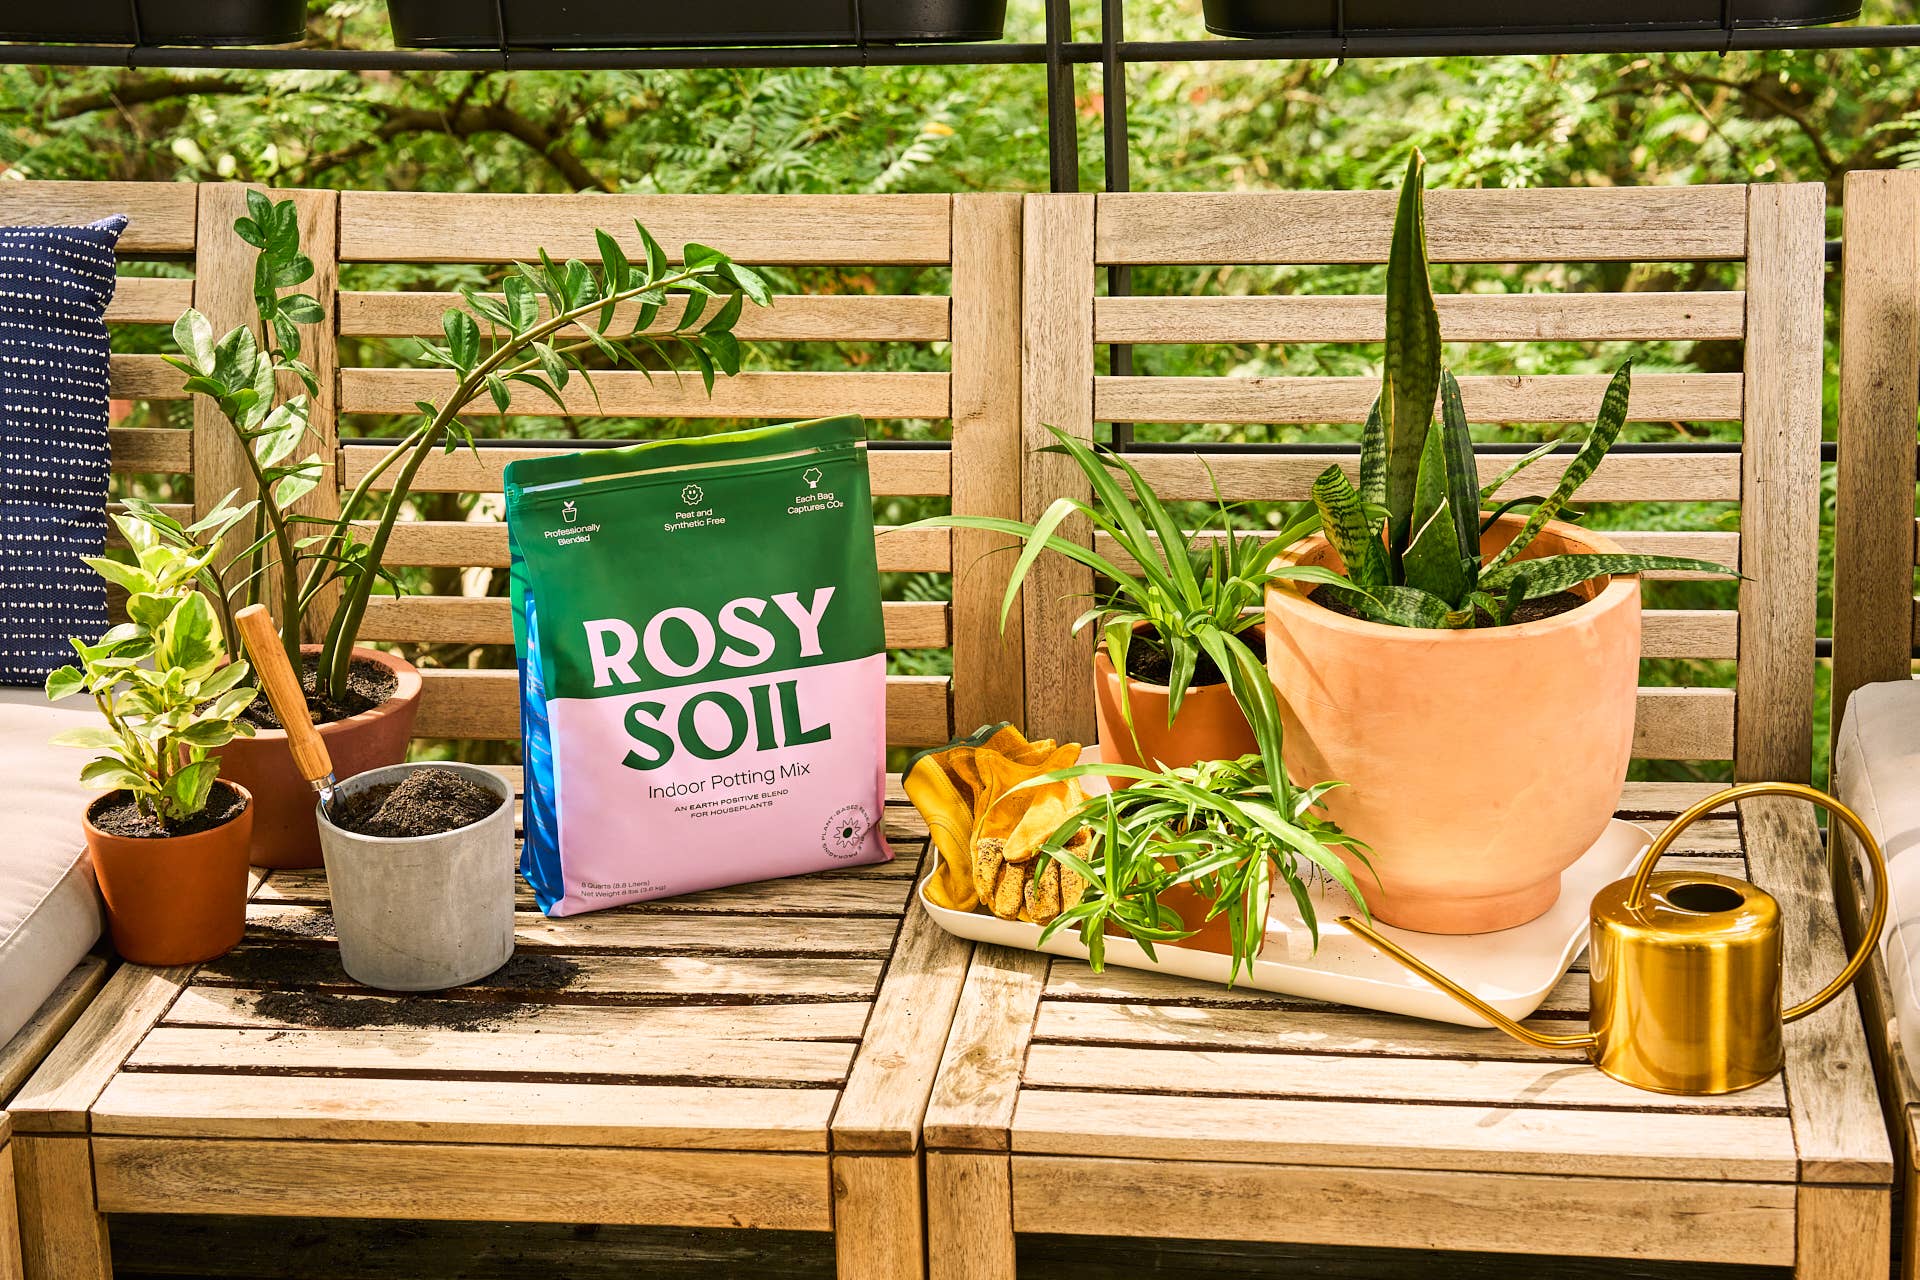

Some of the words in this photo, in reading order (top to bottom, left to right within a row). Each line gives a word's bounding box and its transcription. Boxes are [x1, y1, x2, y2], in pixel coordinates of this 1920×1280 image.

[796, 494, 816, 503] Each
[817, 492, 834, 501] Bag
[675, 511, 695, 520] Peat
[696, 508, 713, 517] and
[787, 503, 826, 514] Captures
[543, 523, 601, 539] Professionally
[664, 520, 705, 532] Synthetic
[706, 517, 726, 526] Free
[557, 534, 591, 546] Blended
[582, 586, 836, 688] ROSY
[621, 680, 832, 771] SOIL
[649, 779, 706, 799] Indoor
[712, 769, 775, 789] Potting
[780, 762, 811, 778] Mix
[689, 801, 719, 811] EARTH
[720, 793, 759, 805] POSITIVE
[761, 789, 789, 799] BLEND
[710, 801, 773, 816] HOUSEPLANTS
[595, 890, 620, 898] Weight
